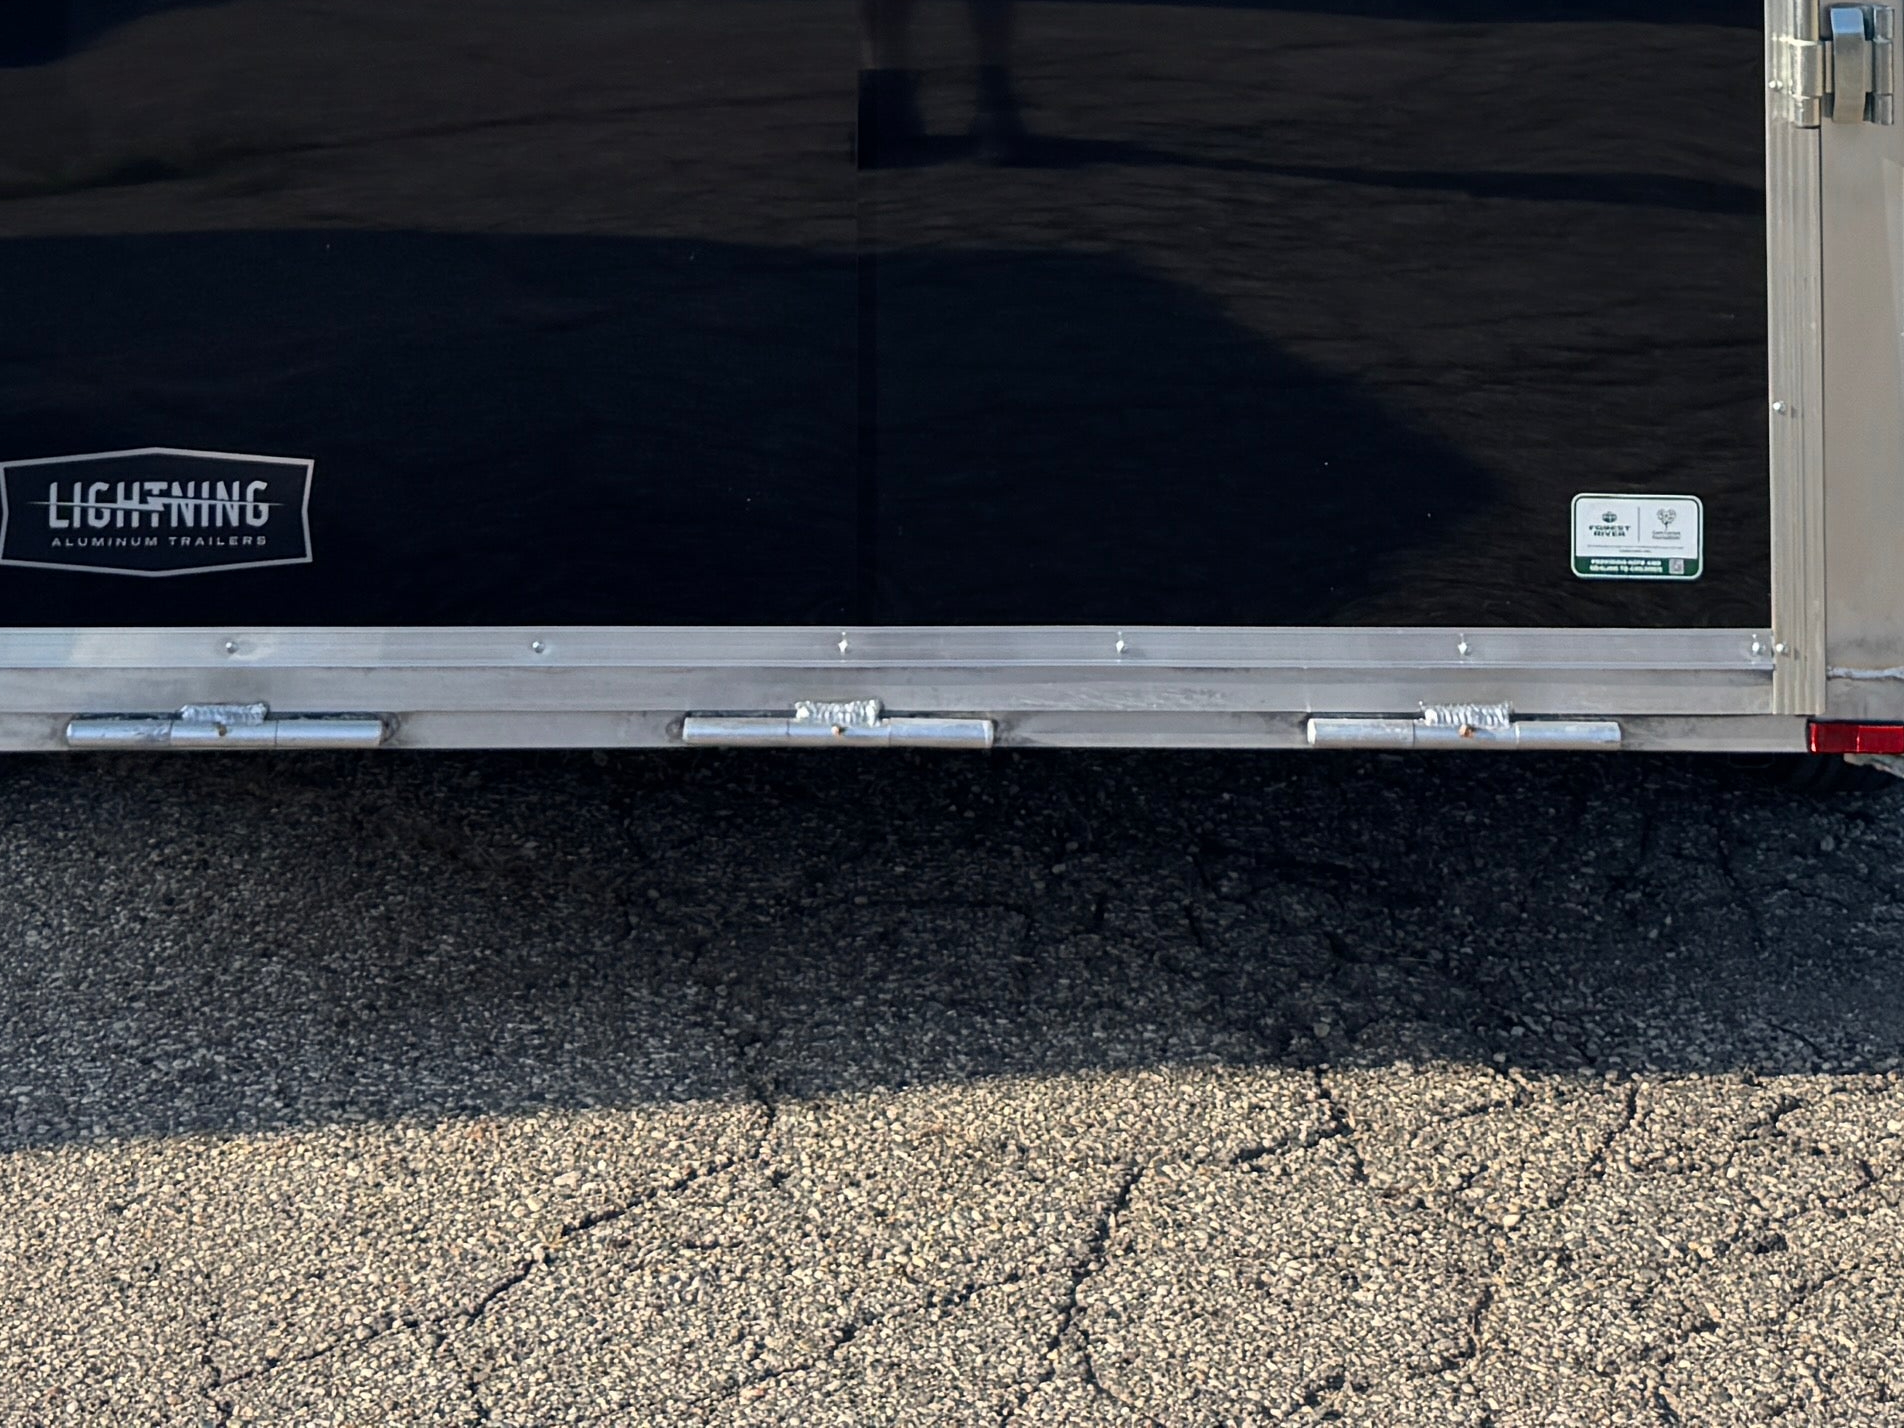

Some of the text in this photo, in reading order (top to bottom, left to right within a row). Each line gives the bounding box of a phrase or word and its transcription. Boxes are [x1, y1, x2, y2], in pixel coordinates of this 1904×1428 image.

[48, 480, 270, 529] LIGHTNING
[51, 535, 267, 548] ALUMINUM TRAILERS
